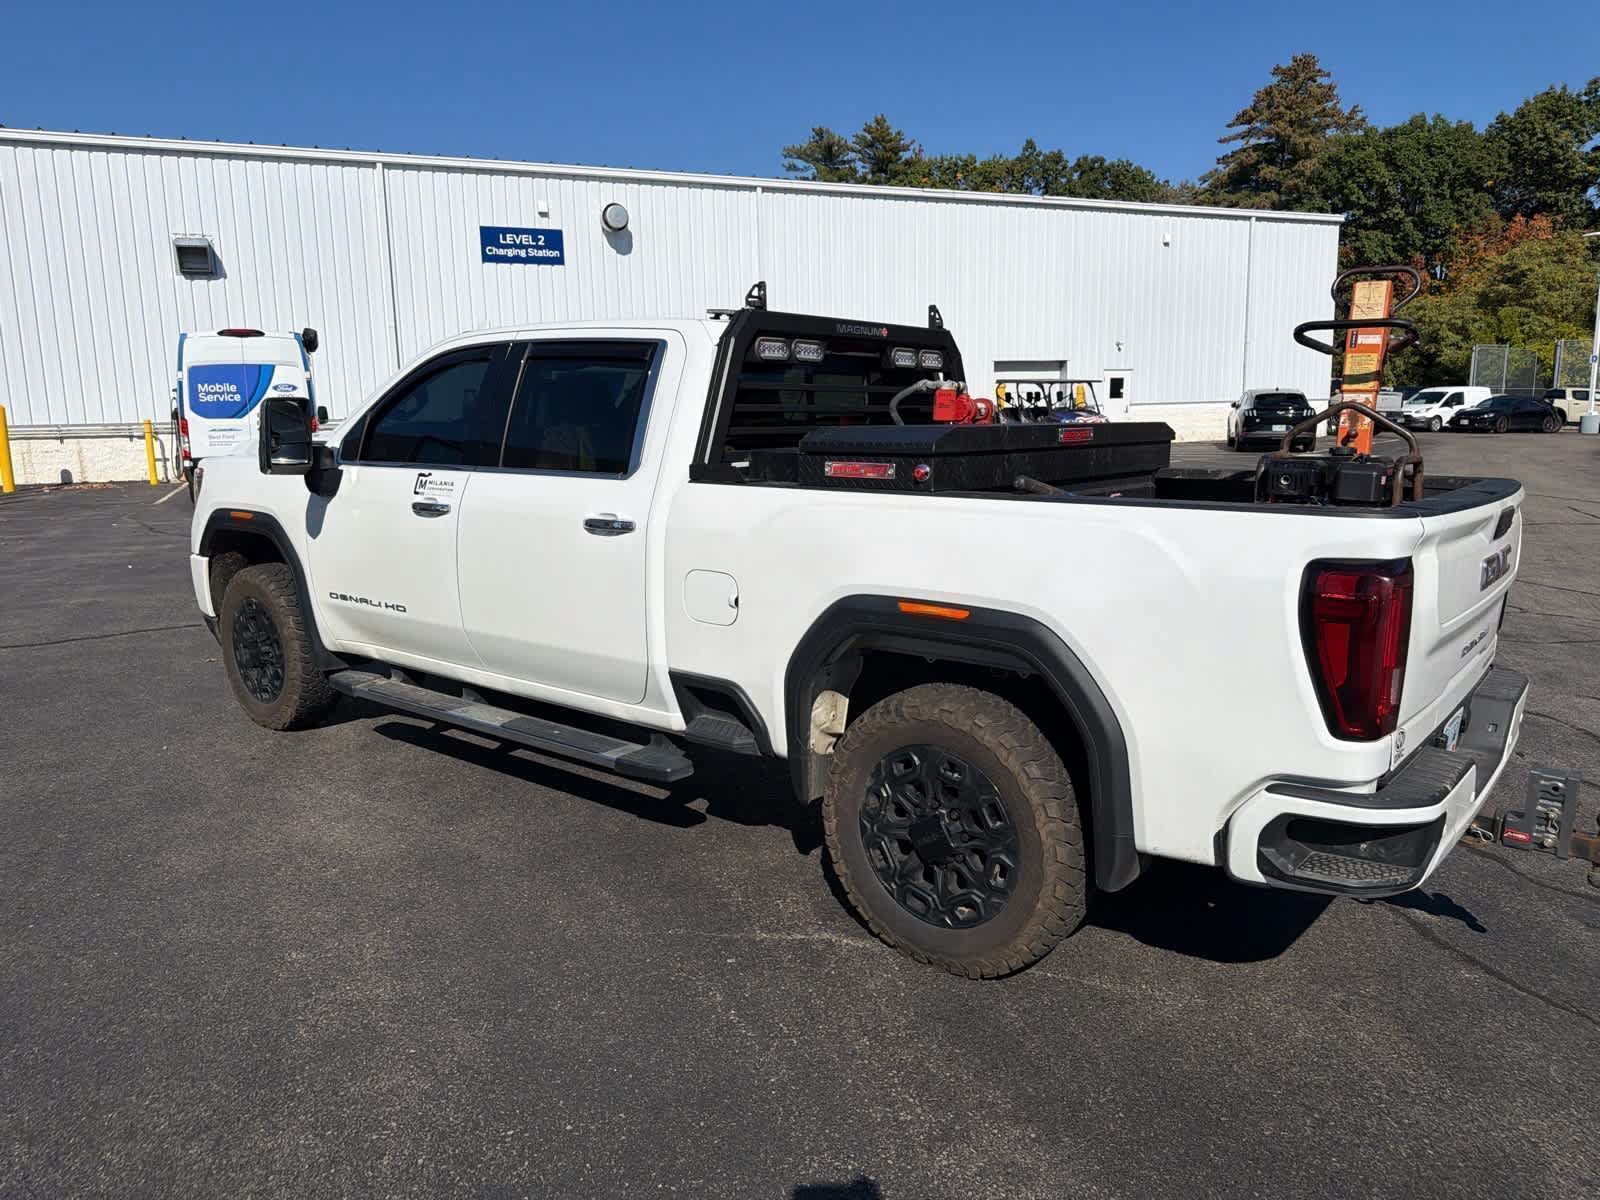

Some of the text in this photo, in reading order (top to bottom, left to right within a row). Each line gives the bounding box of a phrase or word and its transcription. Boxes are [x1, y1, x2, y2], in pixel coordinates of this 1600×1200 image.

[499, 233, 545, 246] LEVEL 2
[486, 246, 560, 258] Charging Station
[836, 324, 881, 336] MAGNUM
[197, 382, 237, 393] Mobile
[199, 392, 241, 402] Service
[329, 592, 407, 613] DENALI HD
